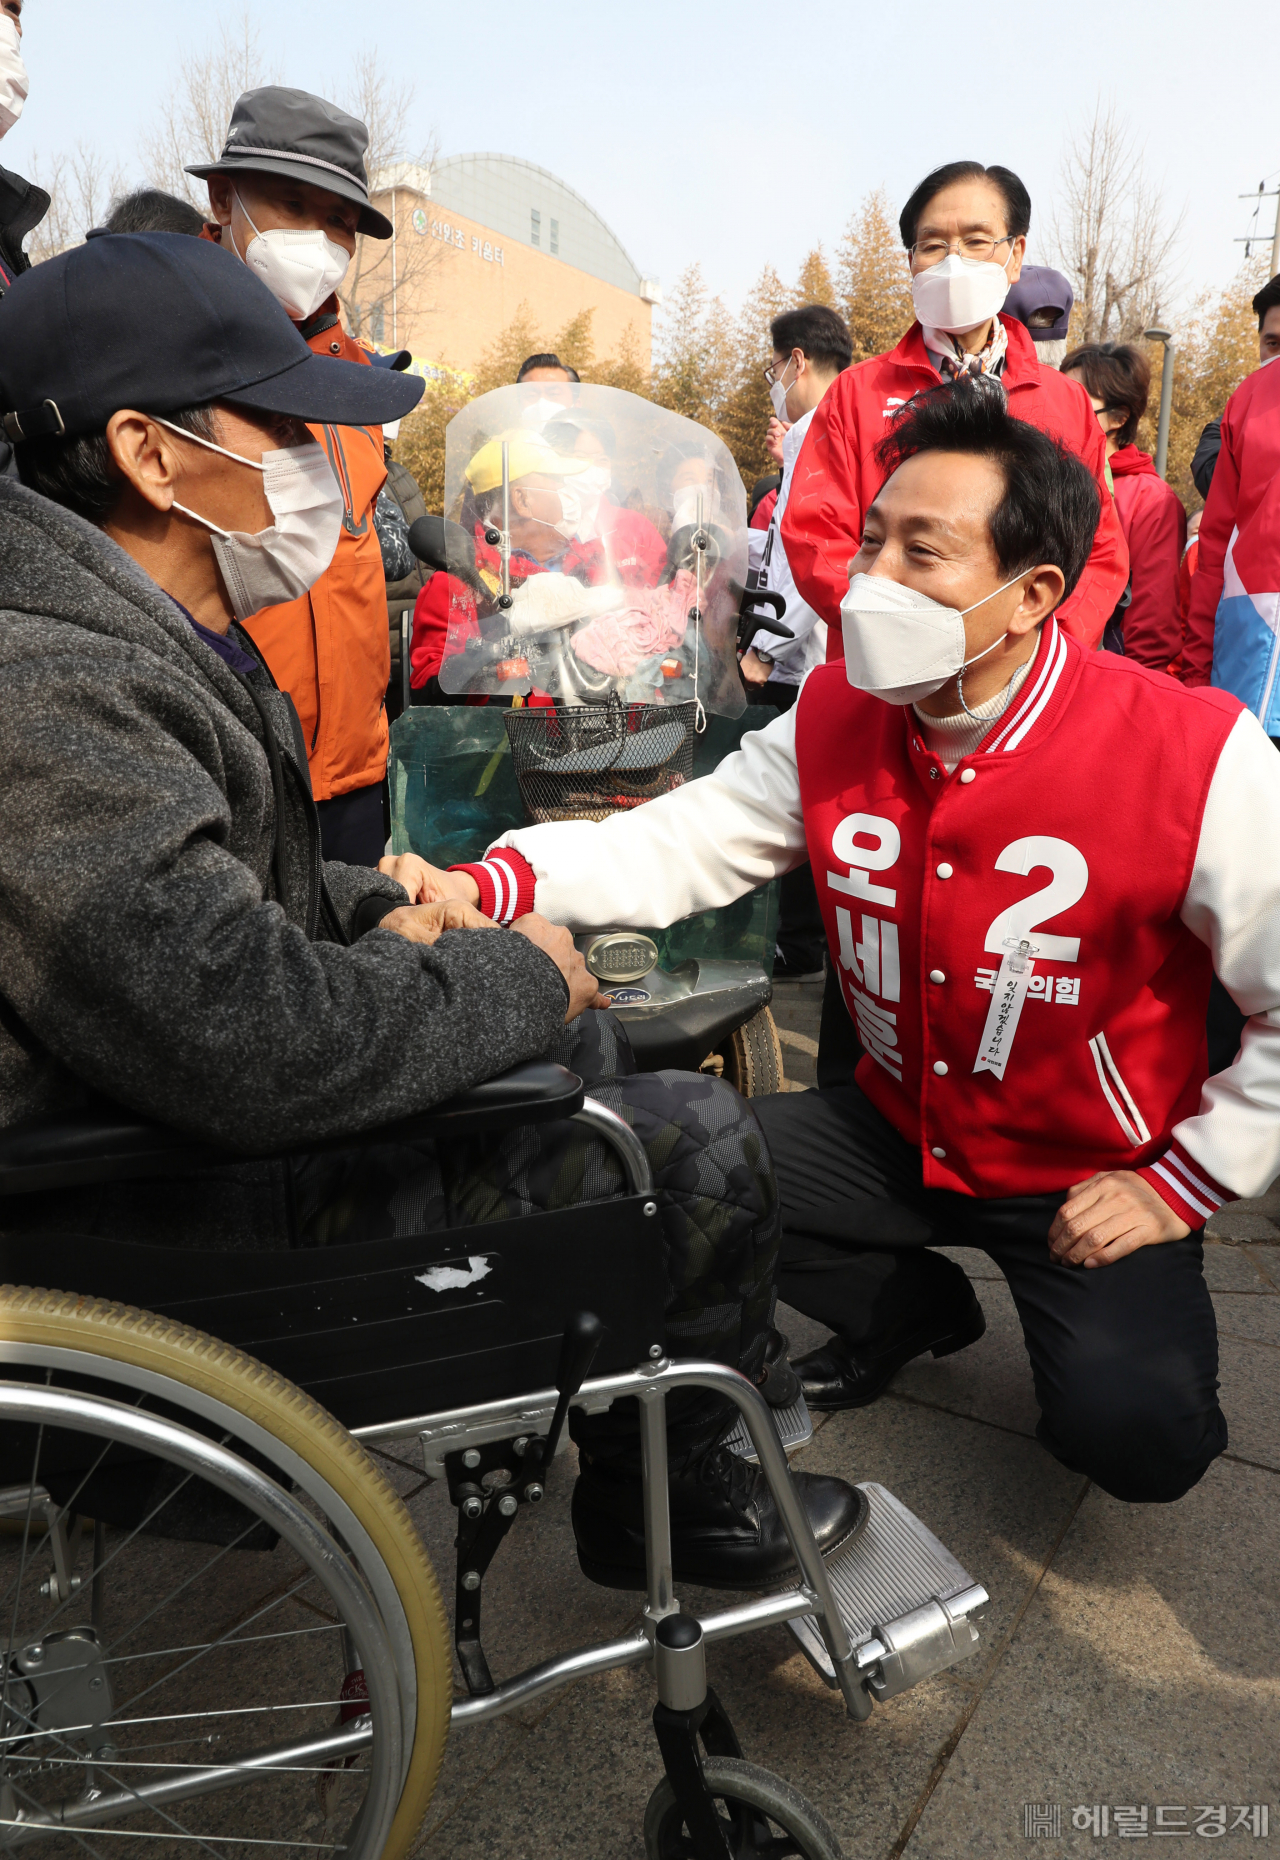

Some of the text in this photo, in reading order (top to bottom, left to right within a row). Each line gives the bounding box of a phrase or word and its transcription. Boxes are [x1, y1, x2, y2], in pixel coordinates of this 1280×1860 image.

[431, 219, 465, 250] 신원초
[984, 835, 1089, 963] 2
[826, 812, 903, 1083] 오세훈
[974, 967, 1081, 1006] 국의힘
